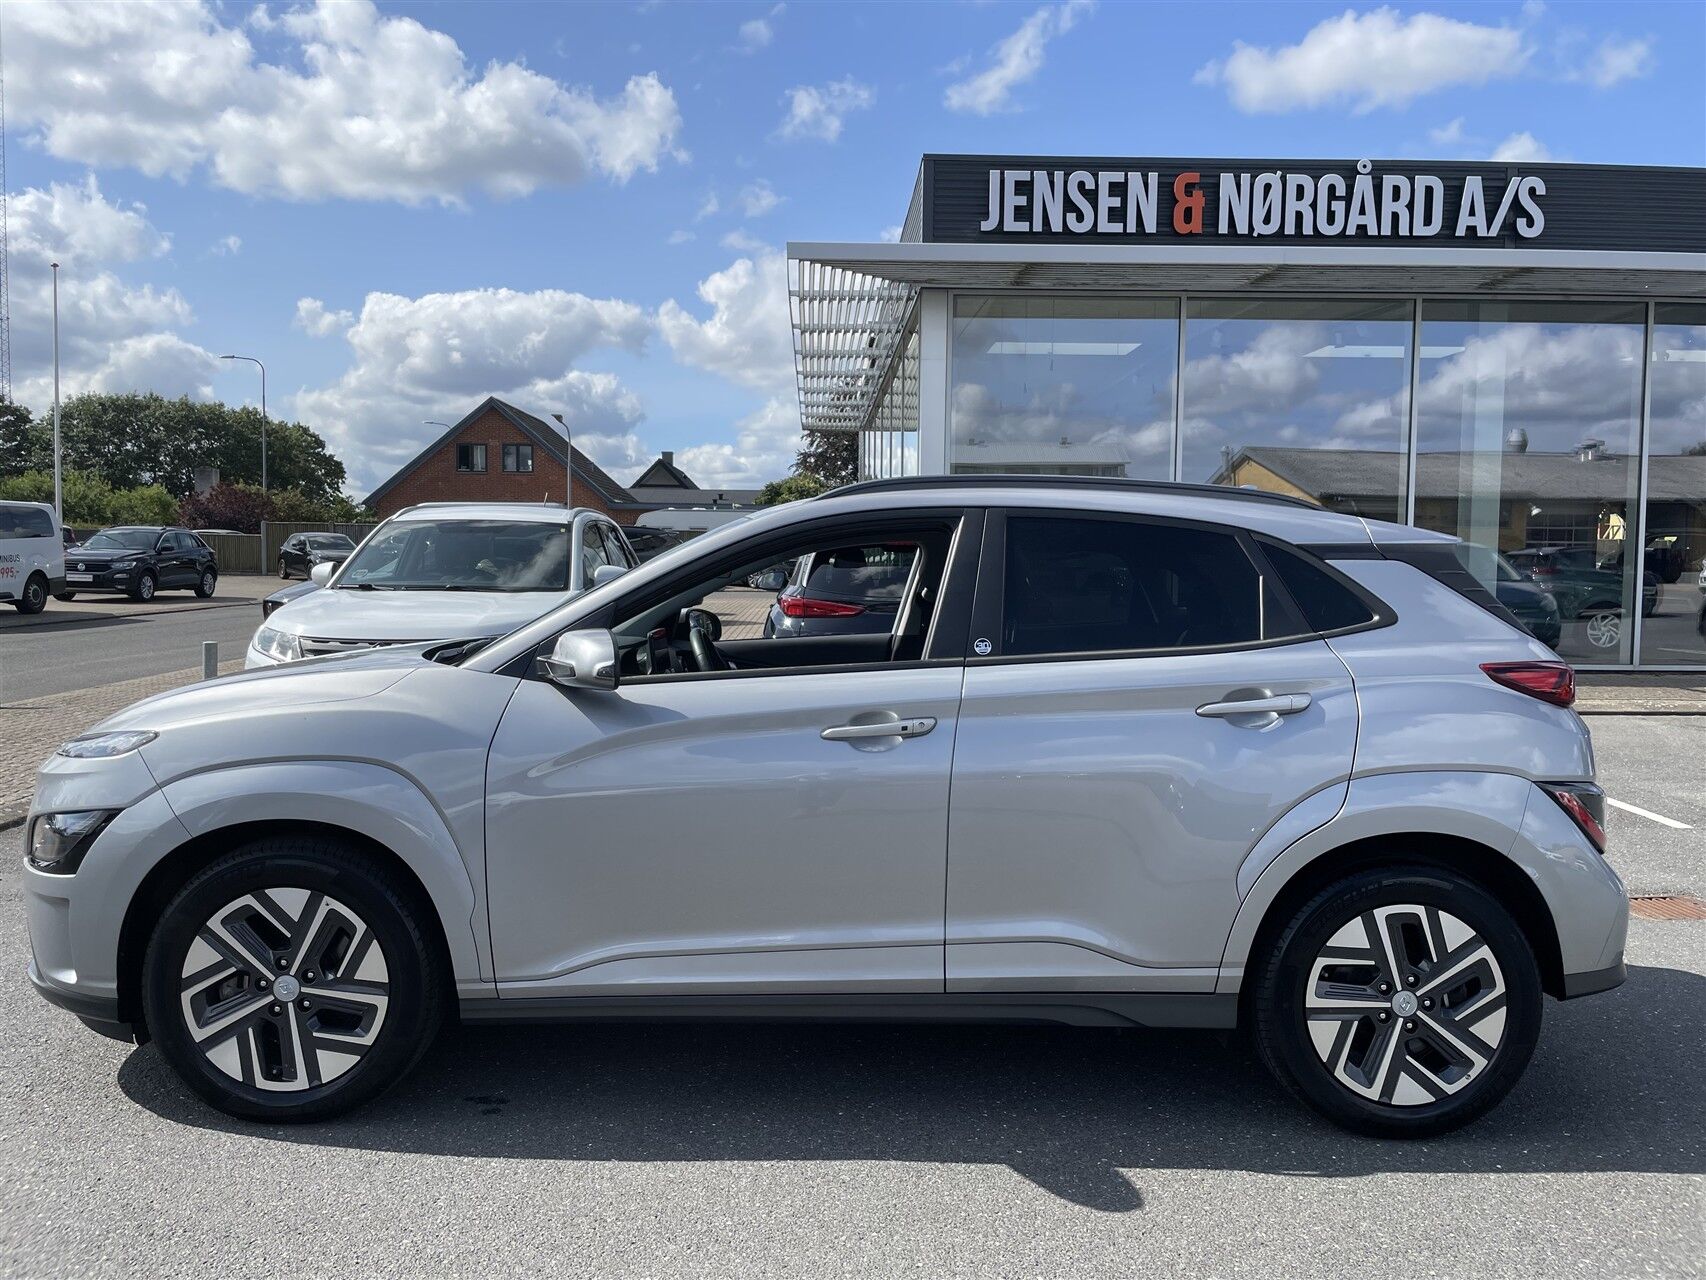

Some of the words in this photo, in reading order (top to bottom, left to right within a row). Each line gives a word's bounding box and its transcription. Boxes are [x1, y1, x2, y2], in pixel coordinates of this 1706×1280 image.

[980, 169, 1159, 234] JENSEN
[1173, 172, 1206, 235] &
[1218, 158, 1445, 237] NØRGÅRD
[1455, 176, 1546, 238] A/S
